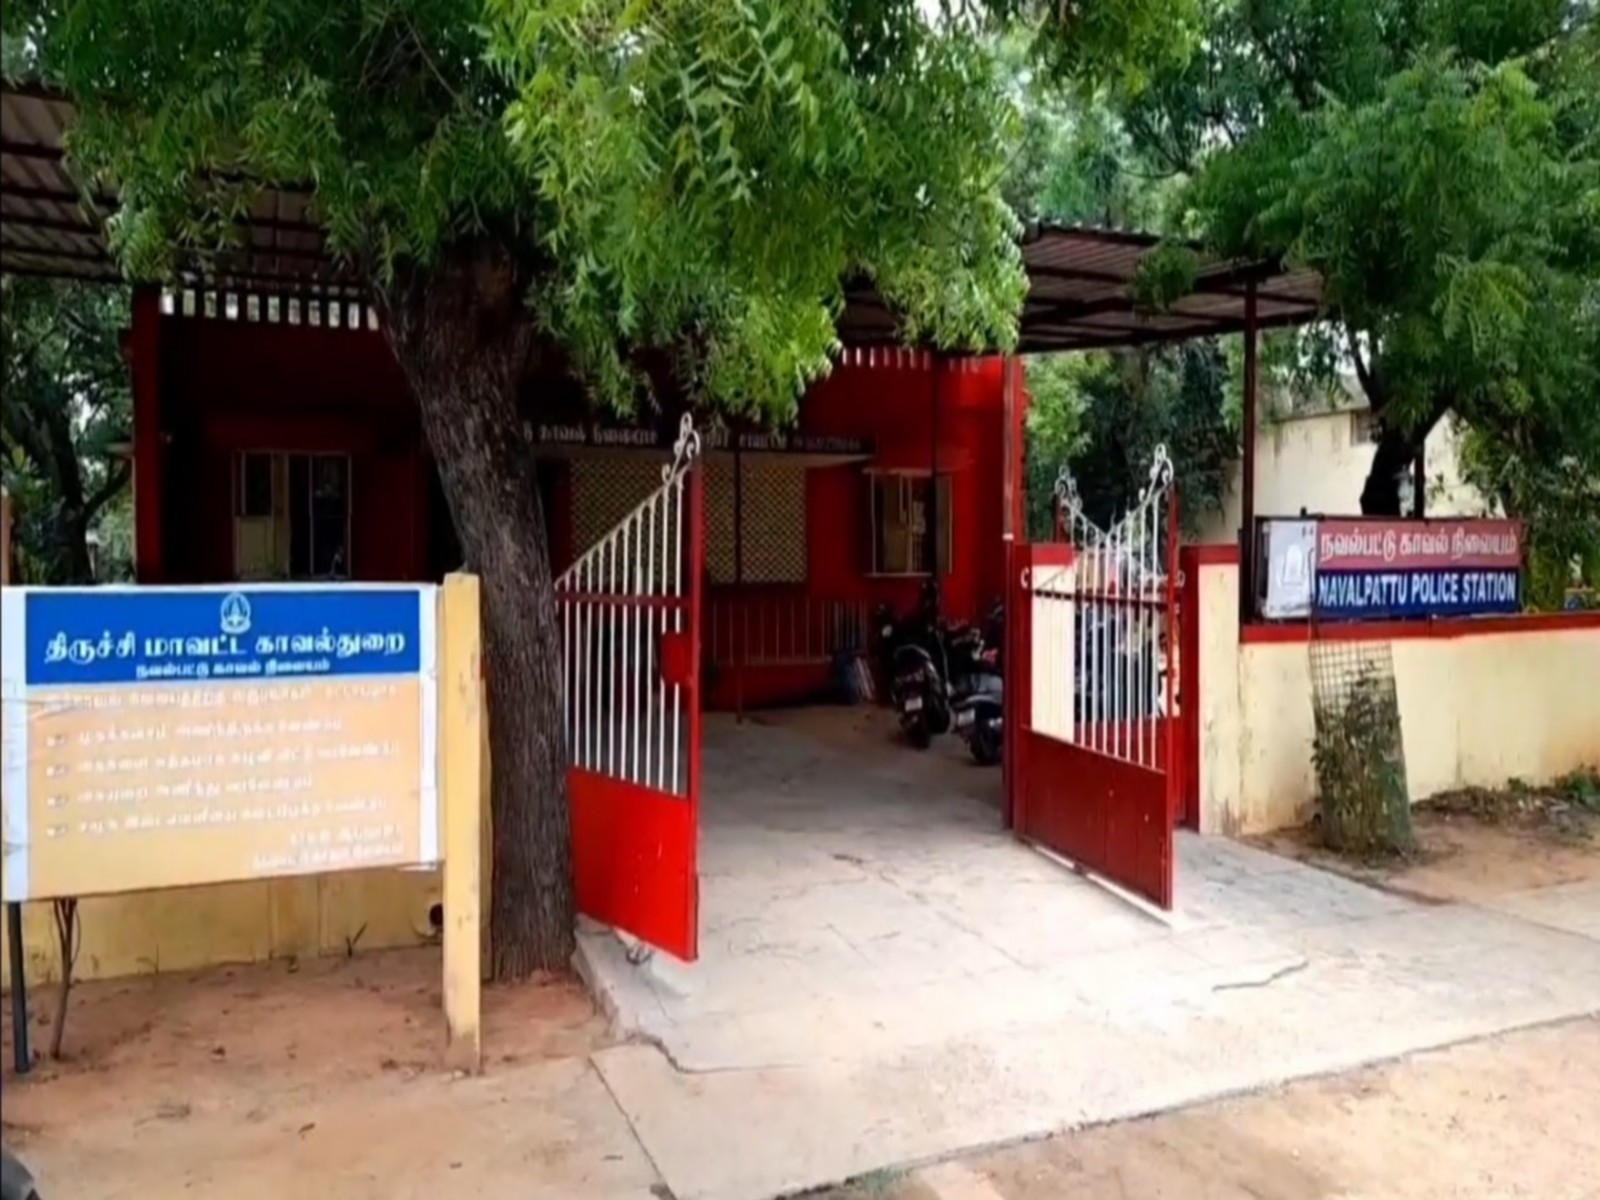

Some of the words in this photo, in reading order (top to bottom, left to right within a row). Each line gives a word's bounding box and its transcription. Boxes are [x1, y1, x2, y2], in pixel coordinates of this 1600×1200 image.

[1320, 527, 1396, 562] நவல்பட்டு
[1400, 527, 1449, 557] காவல்
[1451, 526, 1518, 560] நிலையம்
[1318, 575, 1408, 608] NAVALPATTU
[1411, 573, 1459, 604] POLICE
[1462, 572, 1517, 603] STATION
[44, 629, 136, 666] திருச்சி
[144, 635, 248, 657] மாவட்ட
[255, 626, 406, 658] காவல்துறை
[213, 660, 261, 676] காவல்
[265, 657, 331, 676] நிலையம்
